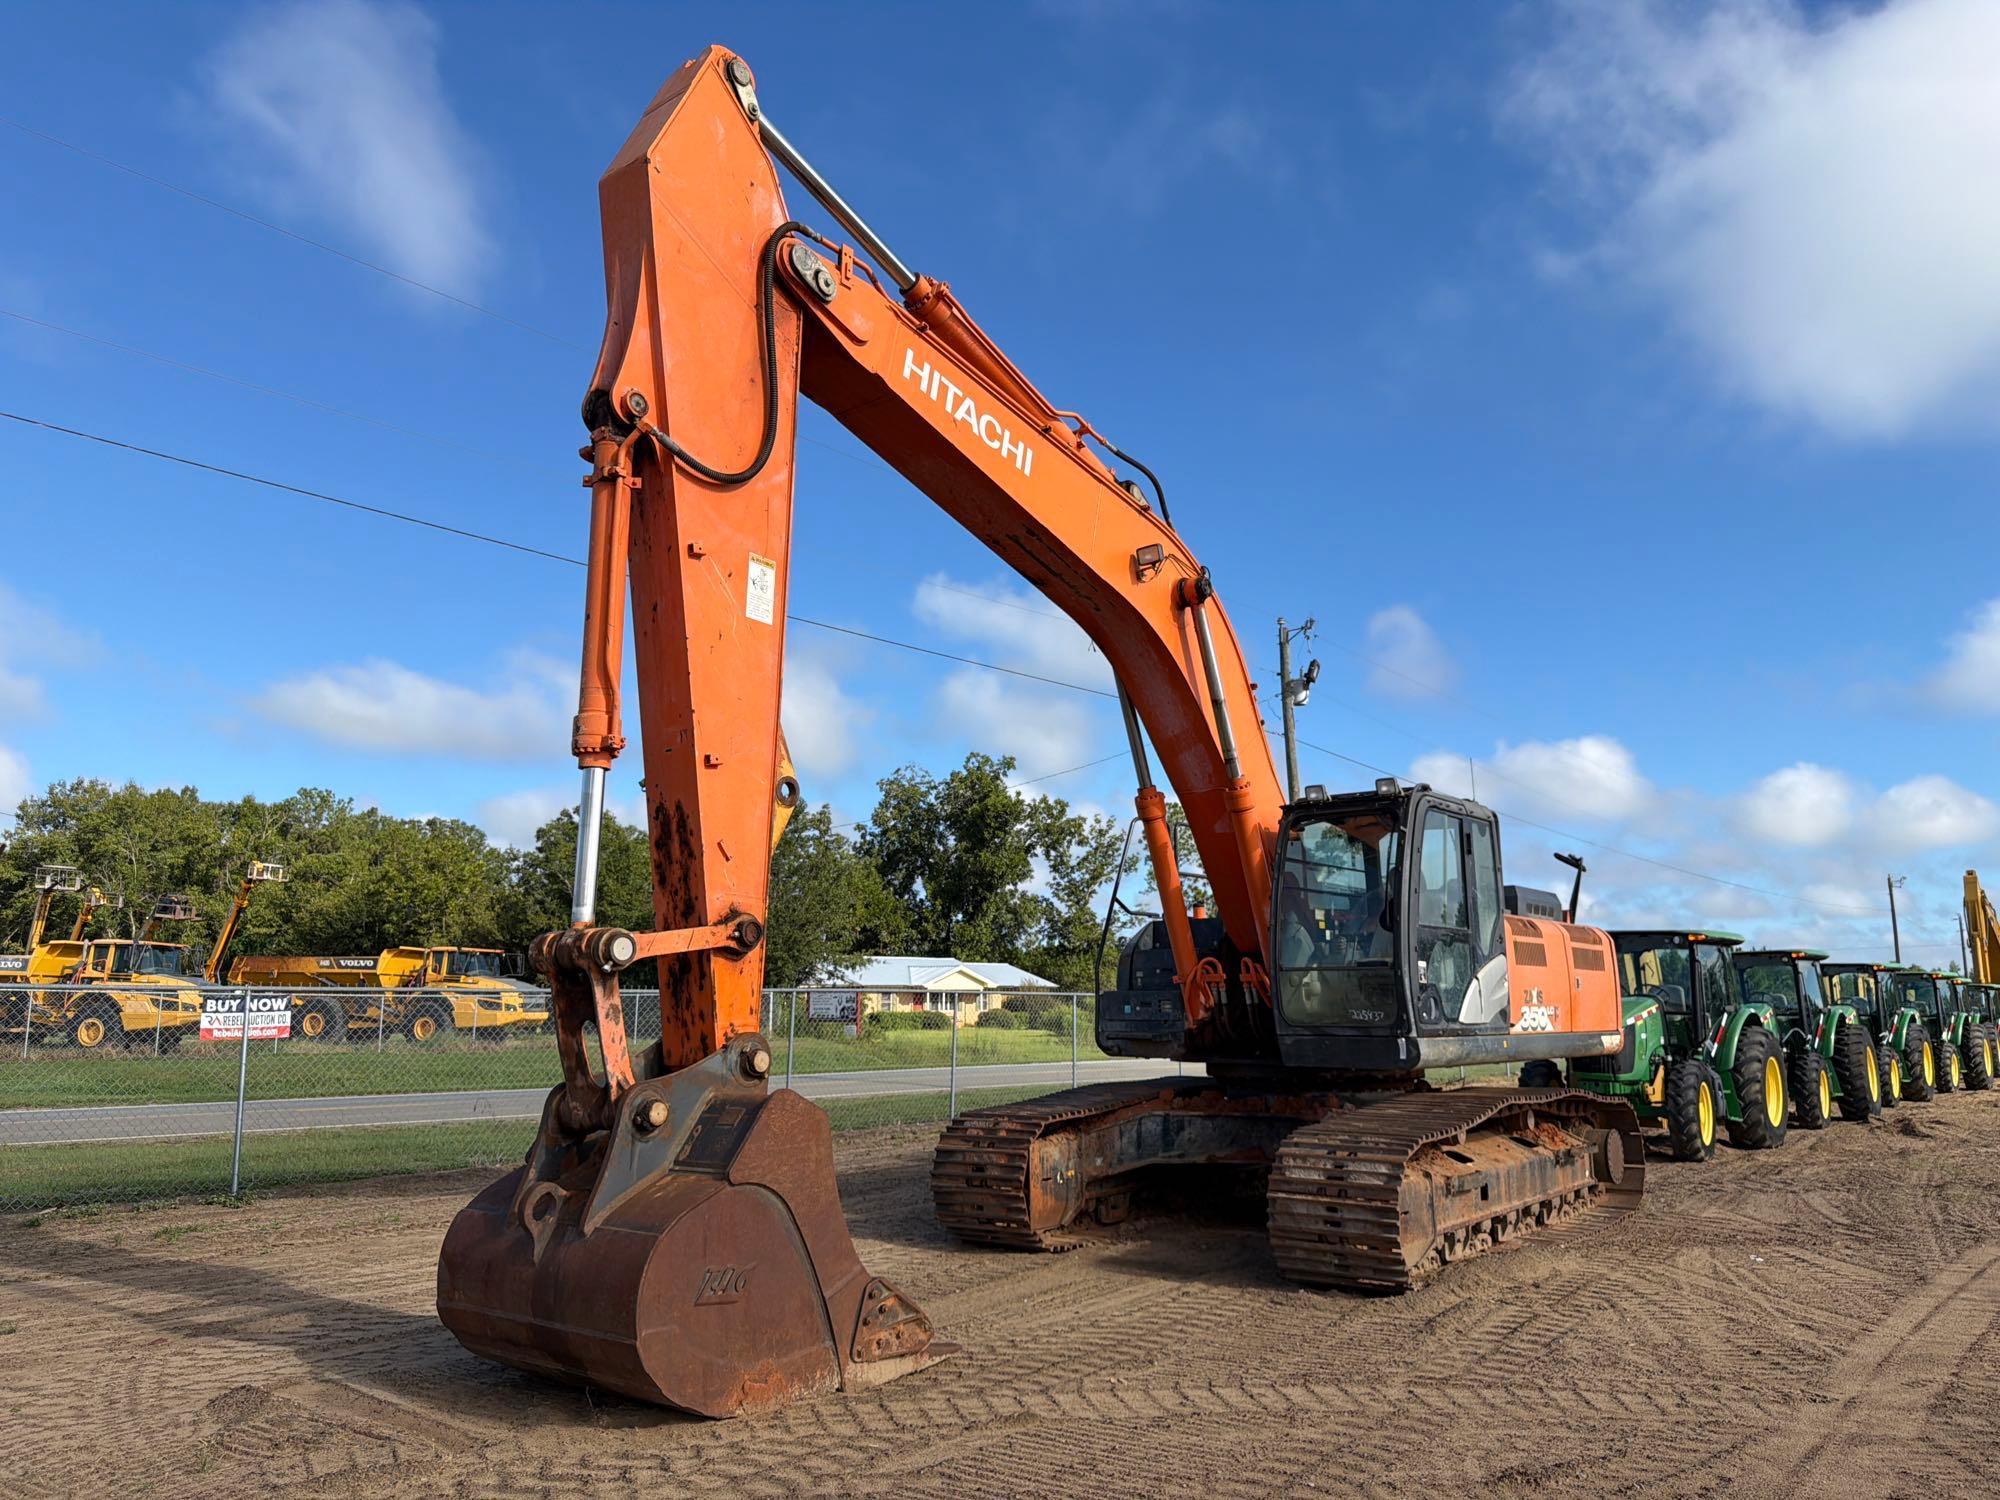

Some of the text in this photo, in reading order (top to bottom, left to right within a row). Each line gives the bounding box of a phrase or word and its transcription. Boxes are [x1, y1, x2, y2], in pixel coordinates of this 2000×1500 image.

[902, 347, 1033, 478] HITACHI
[339, 959, 374, 967] VOLVO
[206, 998, 287, 1012] BUY NOW
[223, 1015, 244, 1026] REBEL
[248, 1013, 276, 1026] UCTION
[1520, 1005, 1548, 1031] 350
